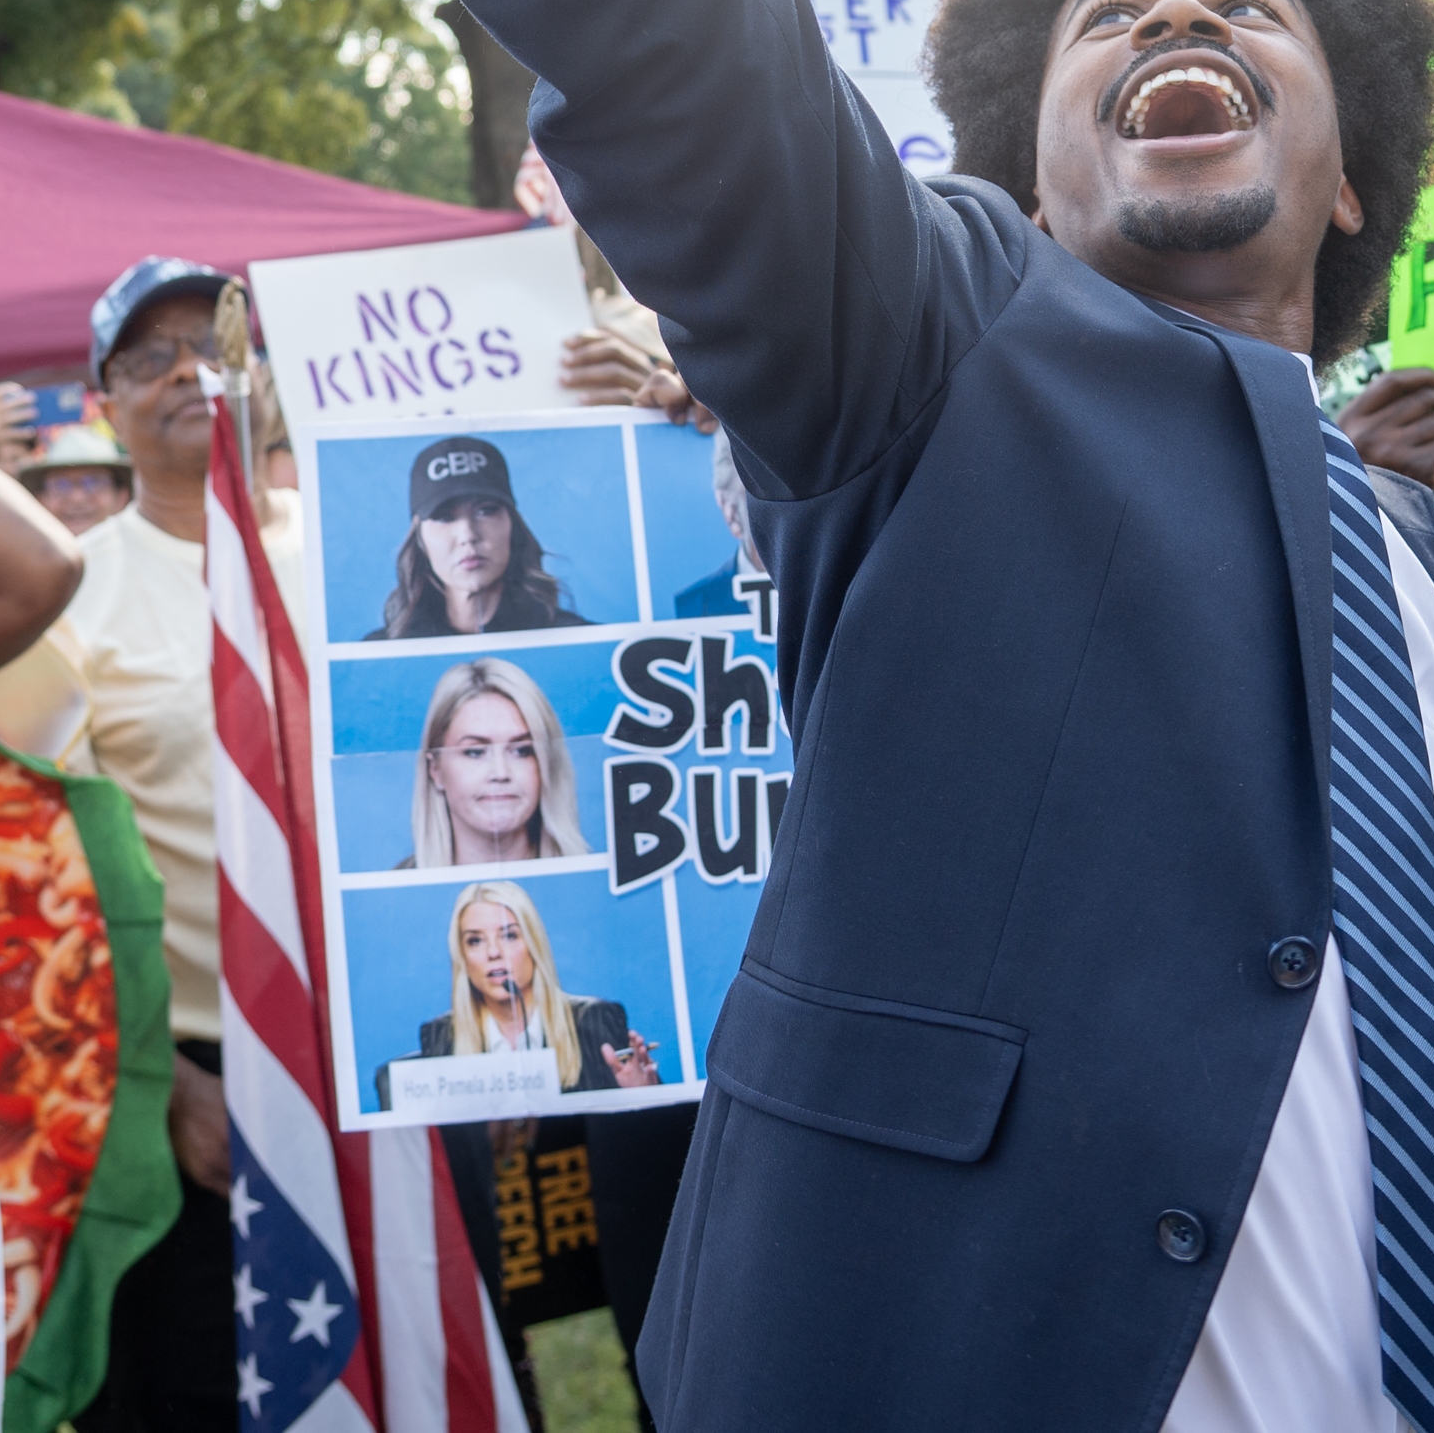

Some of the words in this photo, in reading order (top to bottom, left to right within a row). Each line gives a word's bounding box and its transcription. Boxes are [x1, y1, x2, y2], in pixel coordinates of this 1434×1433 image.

[358, 285, 453, 344] NO
[307, 328, 523, 409] KINGS
[427, 450, 488, 482] CBP
[605, 634, 789, 751] Sh
[536, 1143, 599, 1258] FREE
